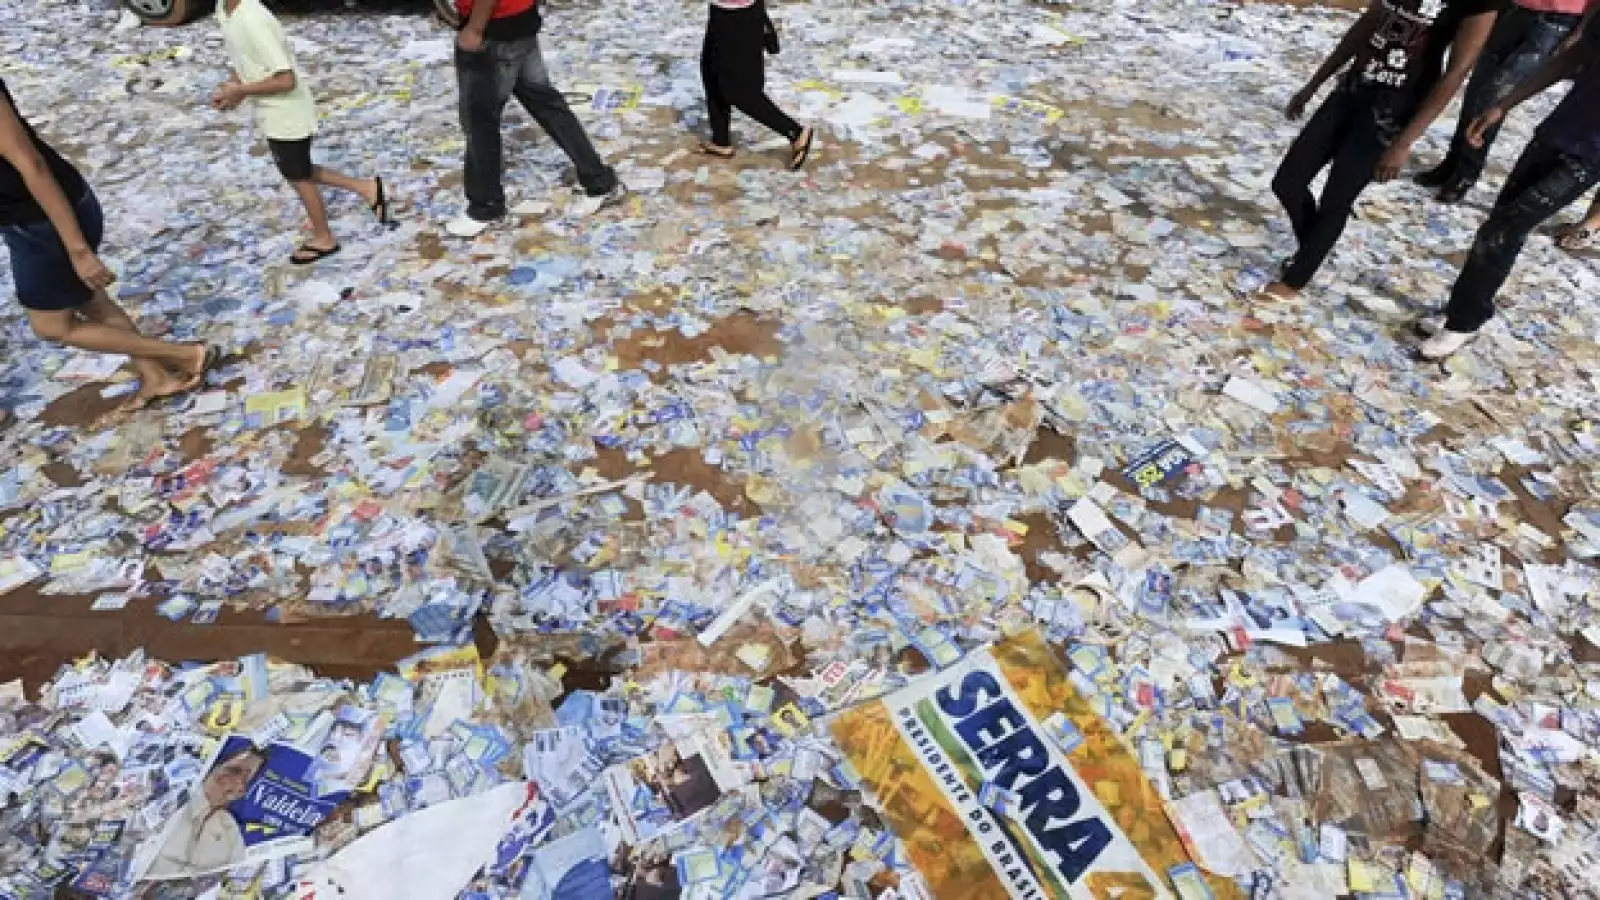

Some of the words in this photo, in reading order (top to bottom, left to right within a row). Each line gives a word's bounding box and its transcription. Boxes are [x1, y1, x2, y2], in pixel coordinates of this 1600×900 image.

[897, 706, 971, 803] PRESIDENTE
[968, 809, 993, 834] DO
[935, 671, 1114, 885] SERRA
